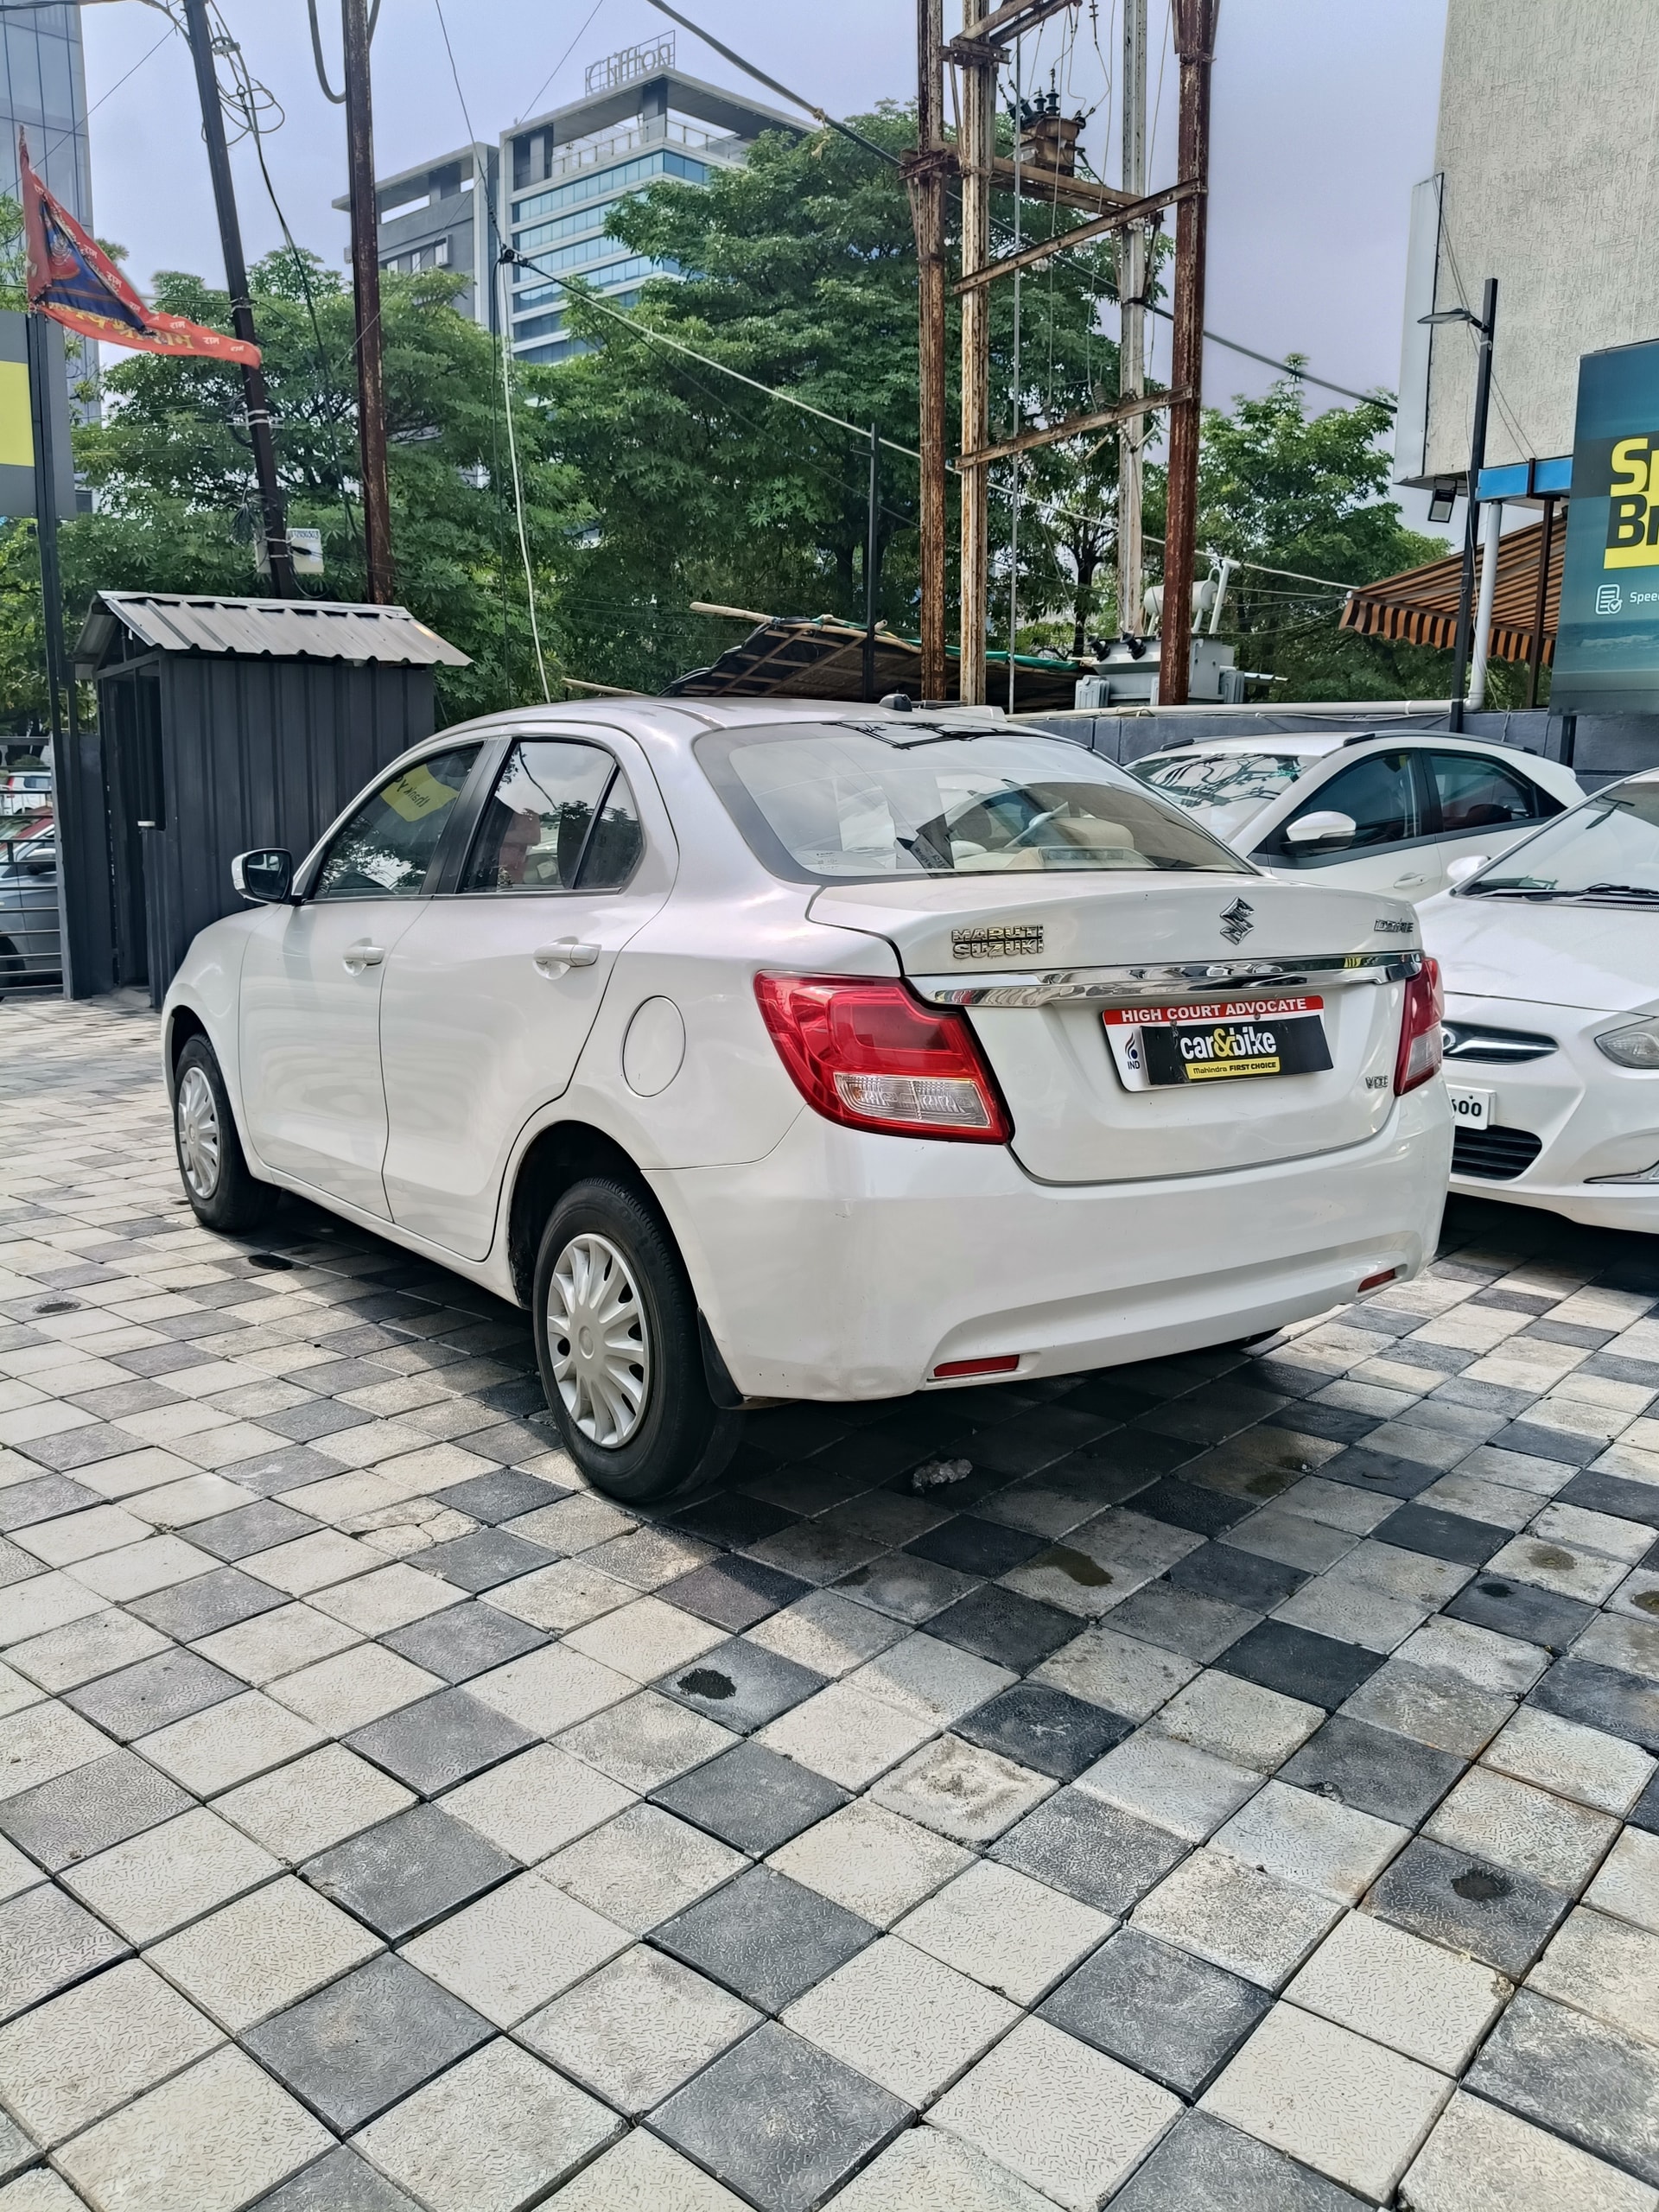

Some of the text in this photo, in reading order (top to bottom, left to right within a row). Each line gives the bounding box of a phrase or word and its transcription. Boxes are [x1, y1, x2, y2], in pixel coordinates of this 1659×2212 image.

[1630, 591, 1659, 605] Spee
[951, 925, 1043, 943] MARUTI
[953, 939, 1044, 959] SUZUKI
[1122, 998, 1307, 1022] HIGH COURT ADVOCATE
[1180, 1027, 1277, 1060] car&bike
[1127, 1060, 1141, 1071] IND
